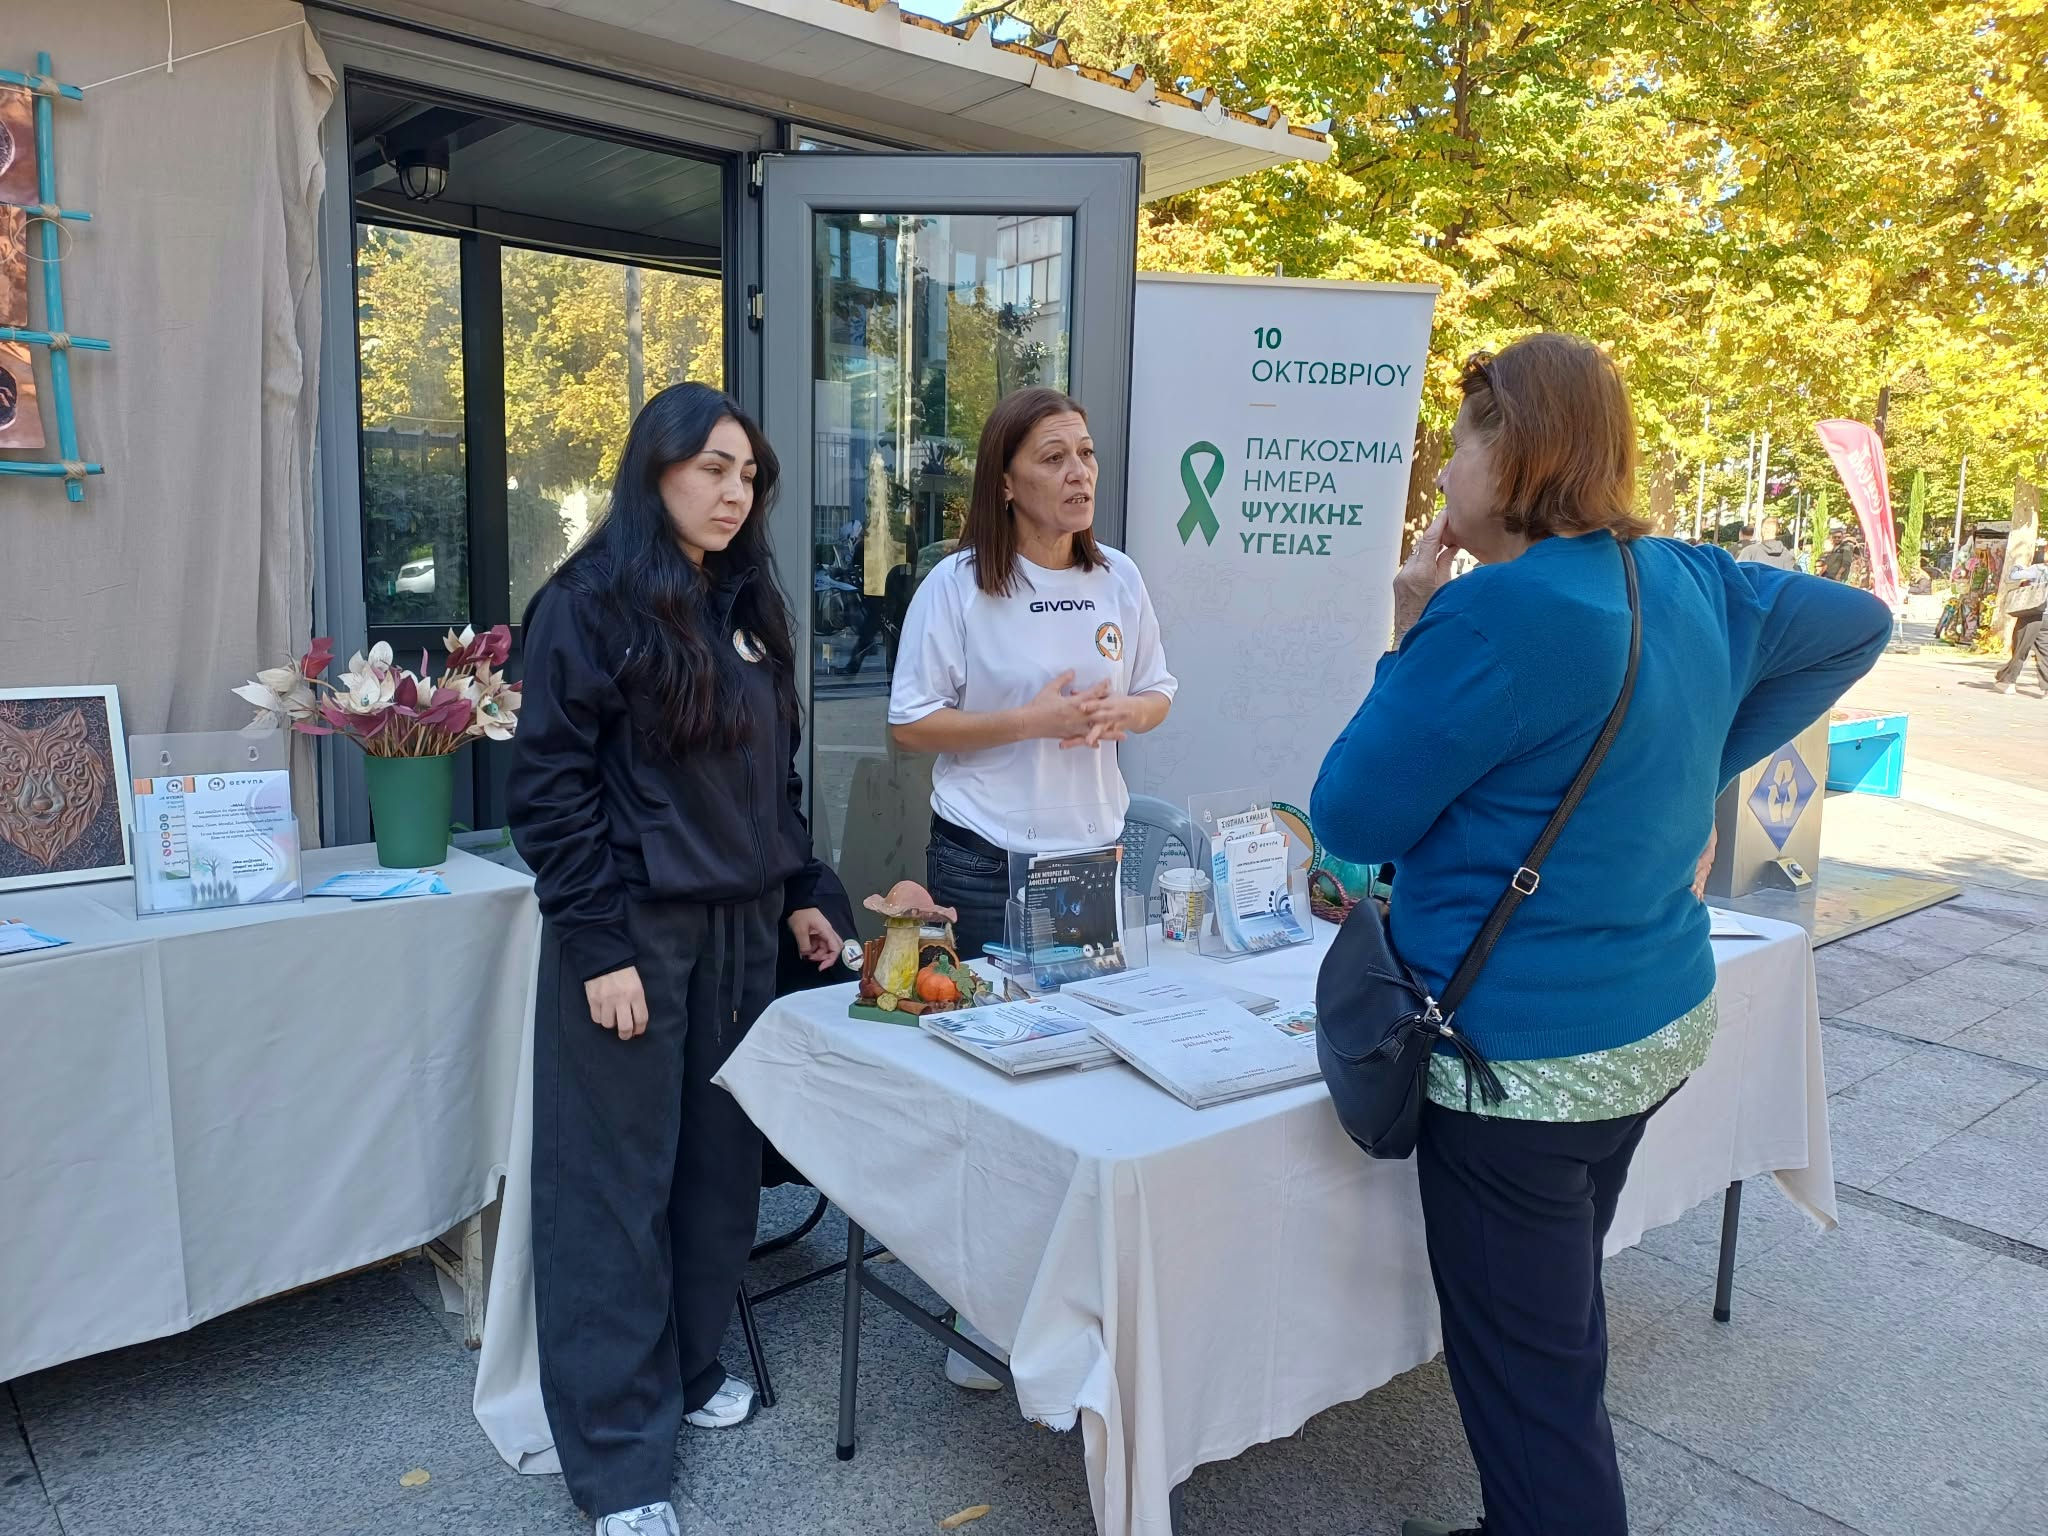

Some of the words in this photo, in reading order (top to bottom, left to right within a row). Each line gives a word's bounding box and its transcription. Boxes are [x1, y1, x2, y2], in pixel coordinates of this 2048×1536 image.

[1253, 326, 1282, 350] 10
[1251, 359, 1412, 387] ΟΚΤΩΒΡΙΟΥ
[1246, 437, 1404, 465] ΠΑΓΚΟΣΜΙΑ
[1243, 469, 1337, 494] ΗΜΕΡΑ
[1241, 501, 1364, 527] ΨΥΧΙΚΗΣ
[1239, 532, 1333, 556] ΥΓΕΙΑΣ
[1029, 599, 1096, 613] GIVOVA
